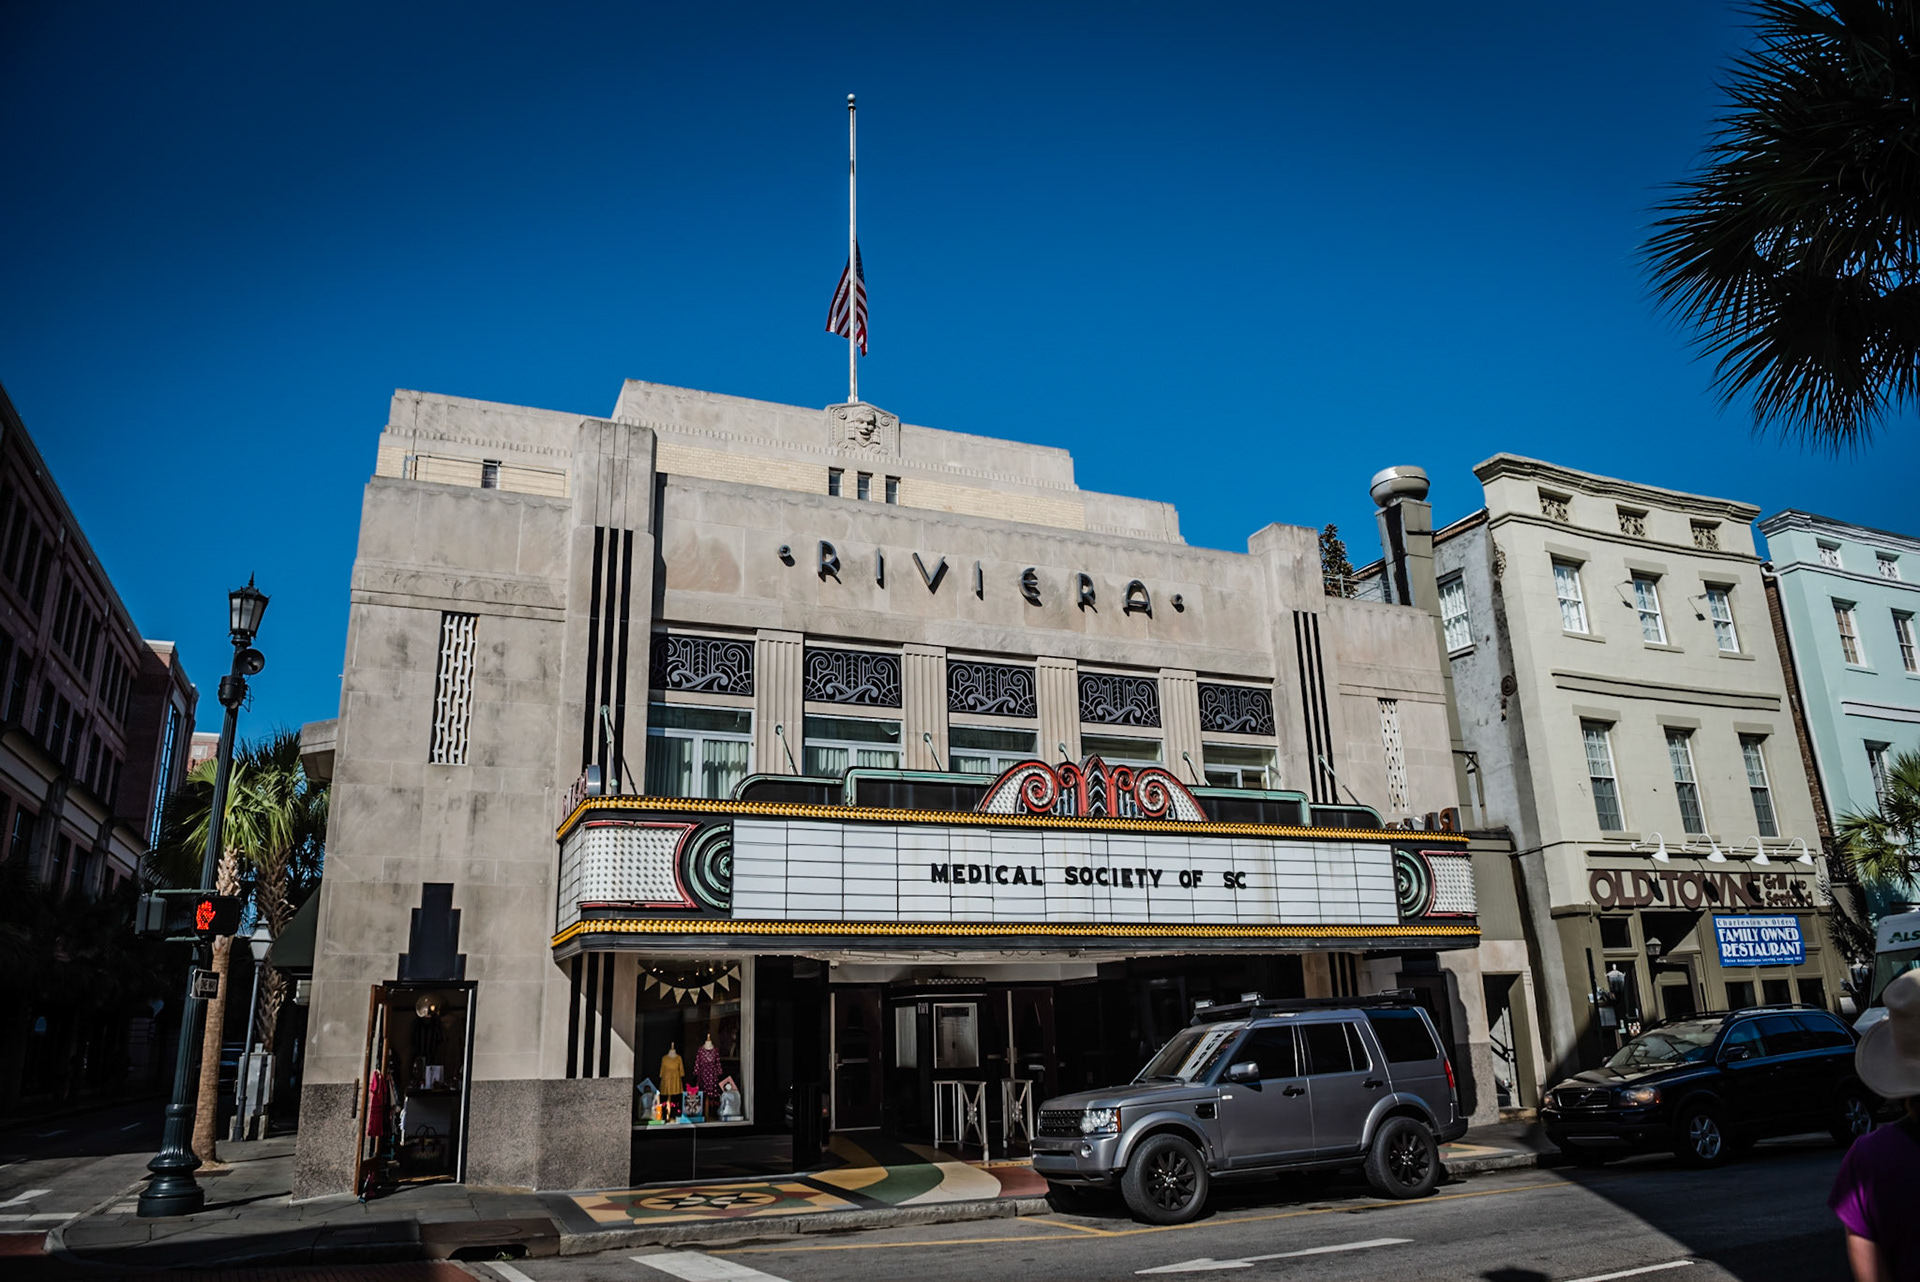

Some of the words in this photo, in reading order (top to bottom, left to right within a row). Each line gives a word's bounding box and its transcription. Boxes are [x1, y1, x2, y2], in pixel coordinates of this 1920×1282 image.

[817, 540, 1152, 615] RIVIERA
[931, 863, 1043, 886] MEDICAL
[1065, 866, 1163, 889] SOCIETY
[1179, 869, 1203, 889] OF
[1223, 871, 1247, 890] SC
[1589, 869, 1655, 909] OLD
[1660, 871, 1764, 911] TOWNE
[1772, 918, 1796, 926] Oldest
[1718, 928, 1759, 942] FAMILY
[1761, 927, 1799, 941] OWNED
[1721, 941, 1801, 958] RESTAURANT
